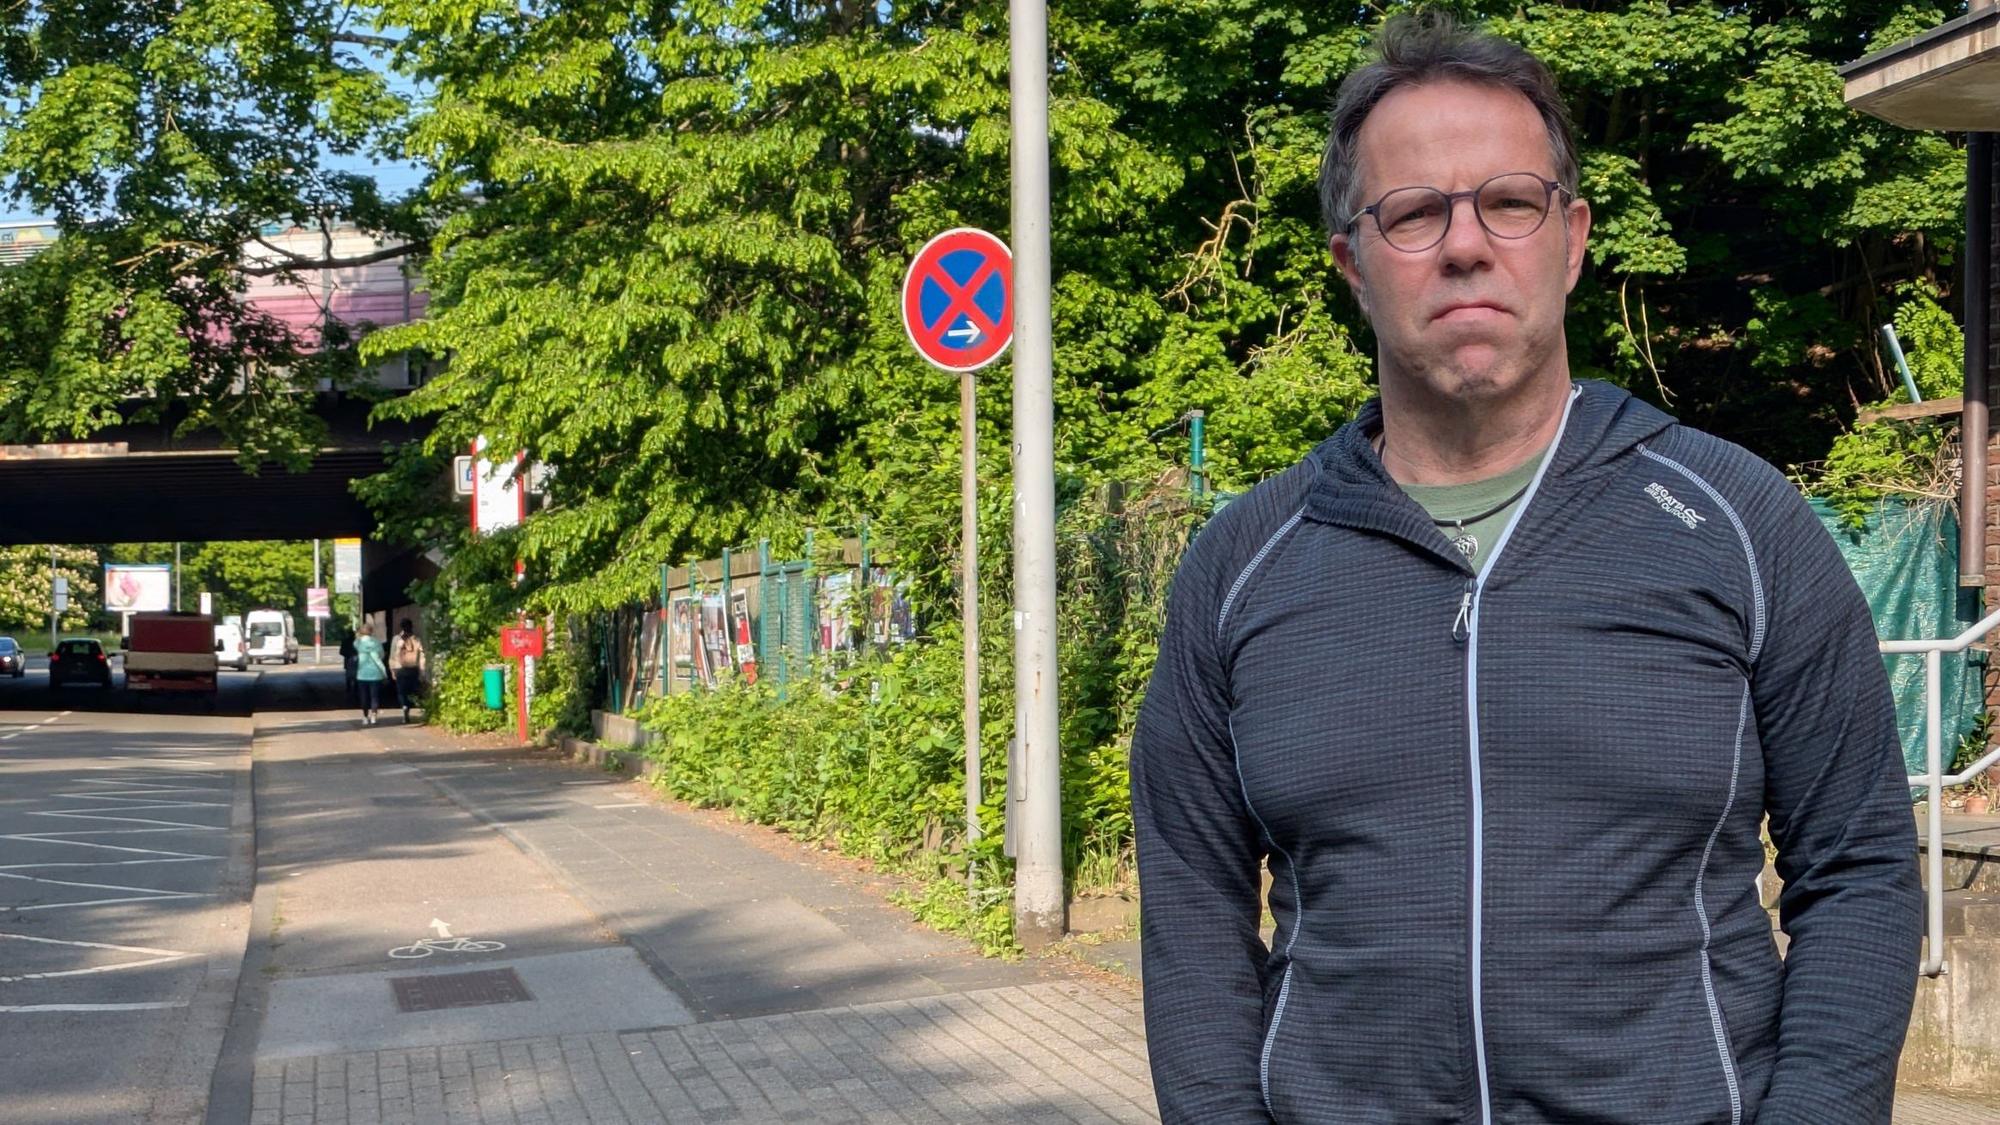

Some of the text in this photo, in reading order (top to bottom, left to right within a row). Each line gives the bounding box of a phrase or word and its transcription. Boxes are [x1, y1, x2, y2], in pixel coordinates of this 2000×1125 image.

[1644, 487, 1697, 529] GREAT OUTDOORS
[1648, 482, 1685, 511] REGATTA
